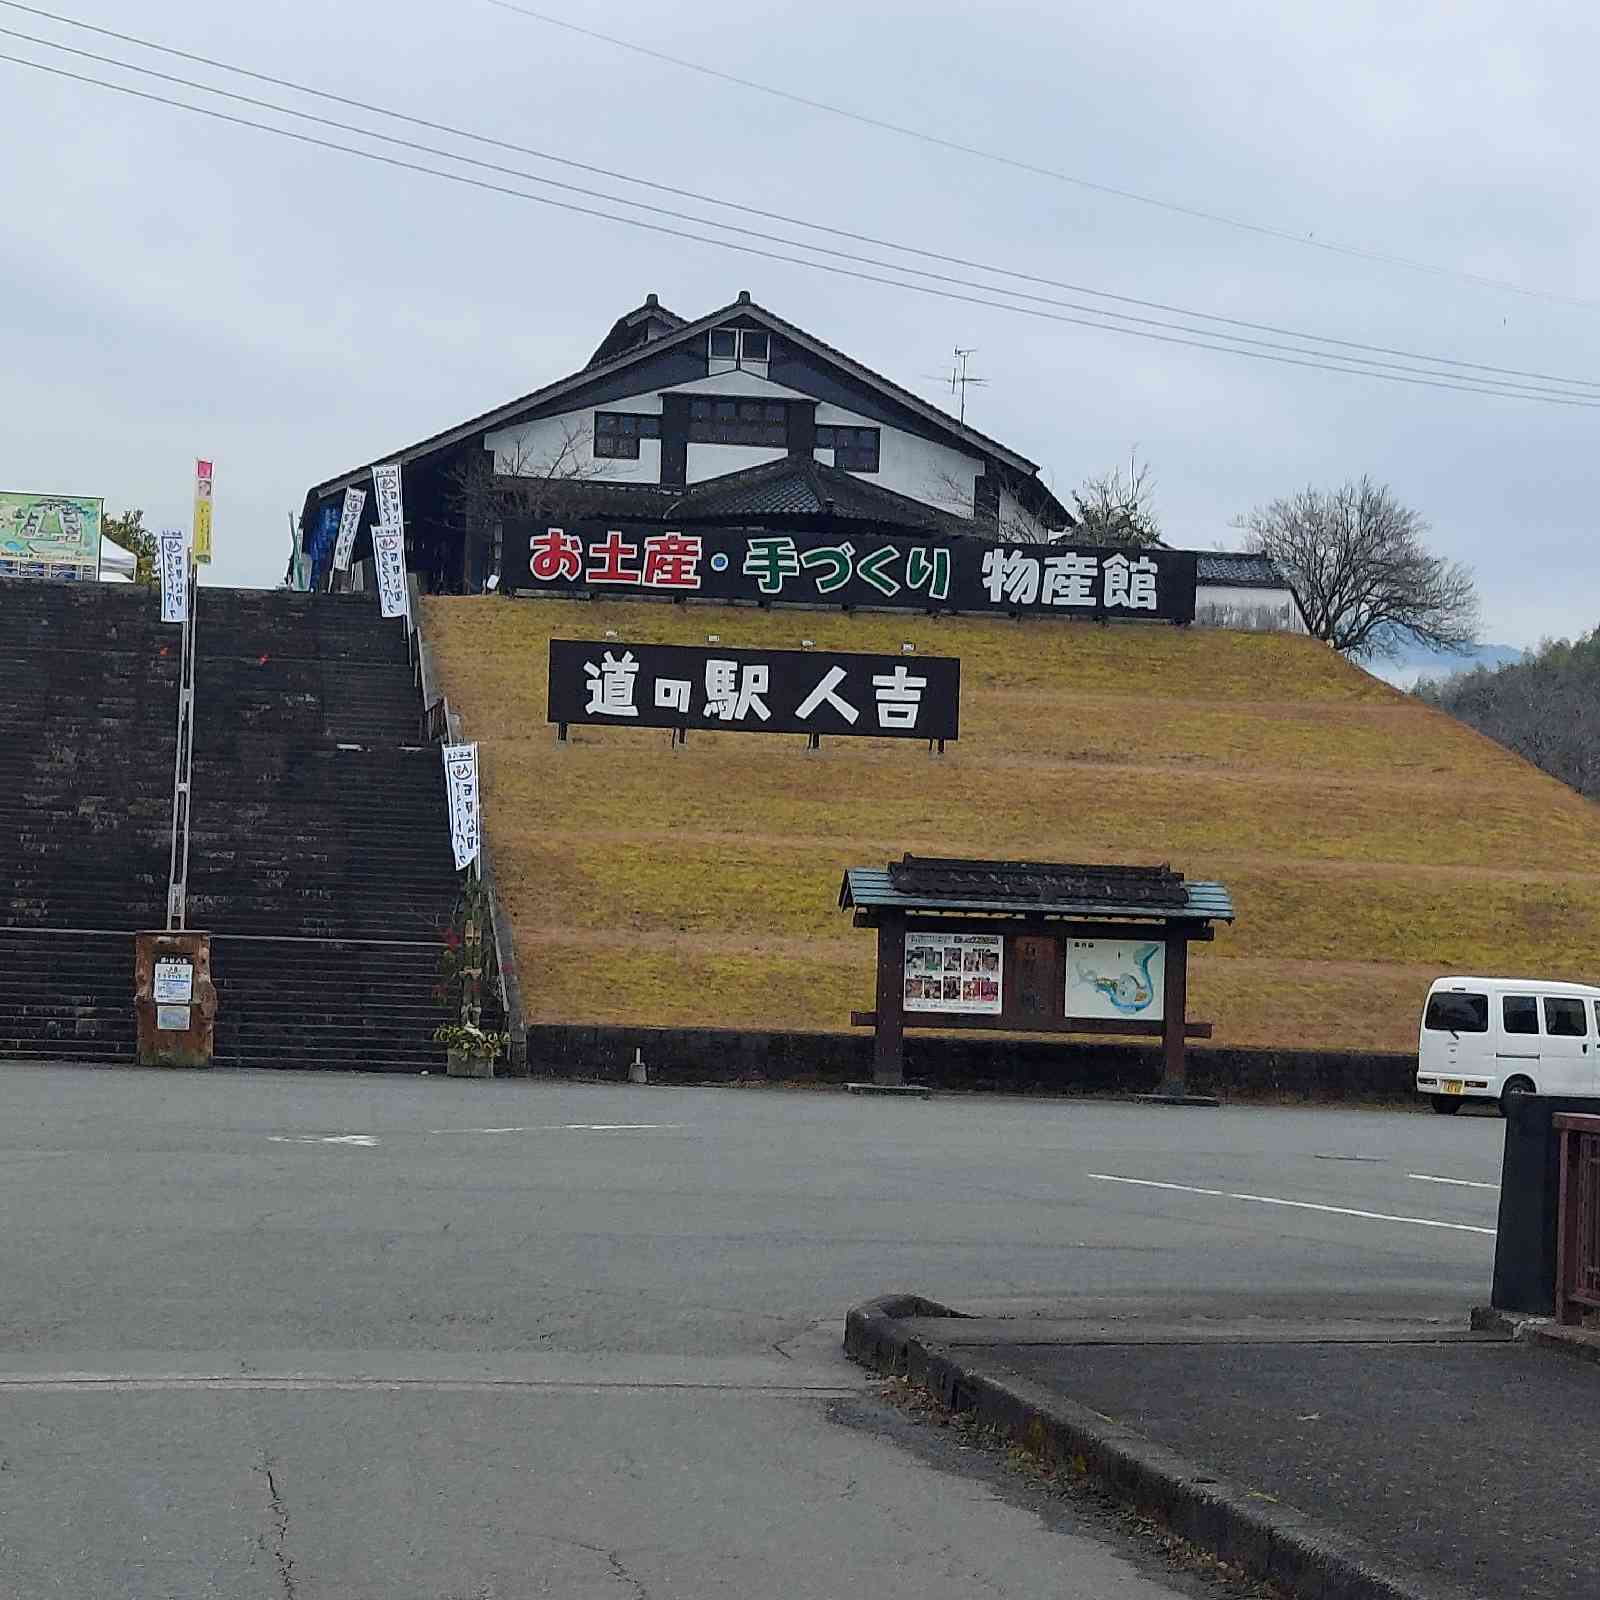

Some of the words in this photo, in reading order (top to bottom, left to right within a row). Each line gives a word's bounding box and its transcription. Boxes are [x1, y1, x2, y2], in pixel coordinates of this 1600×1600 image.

[981, 549, 1159, 611] 物産館
[583, 650, 770, 722] 道の駅
[795, 665, 928, 729] 人吉
